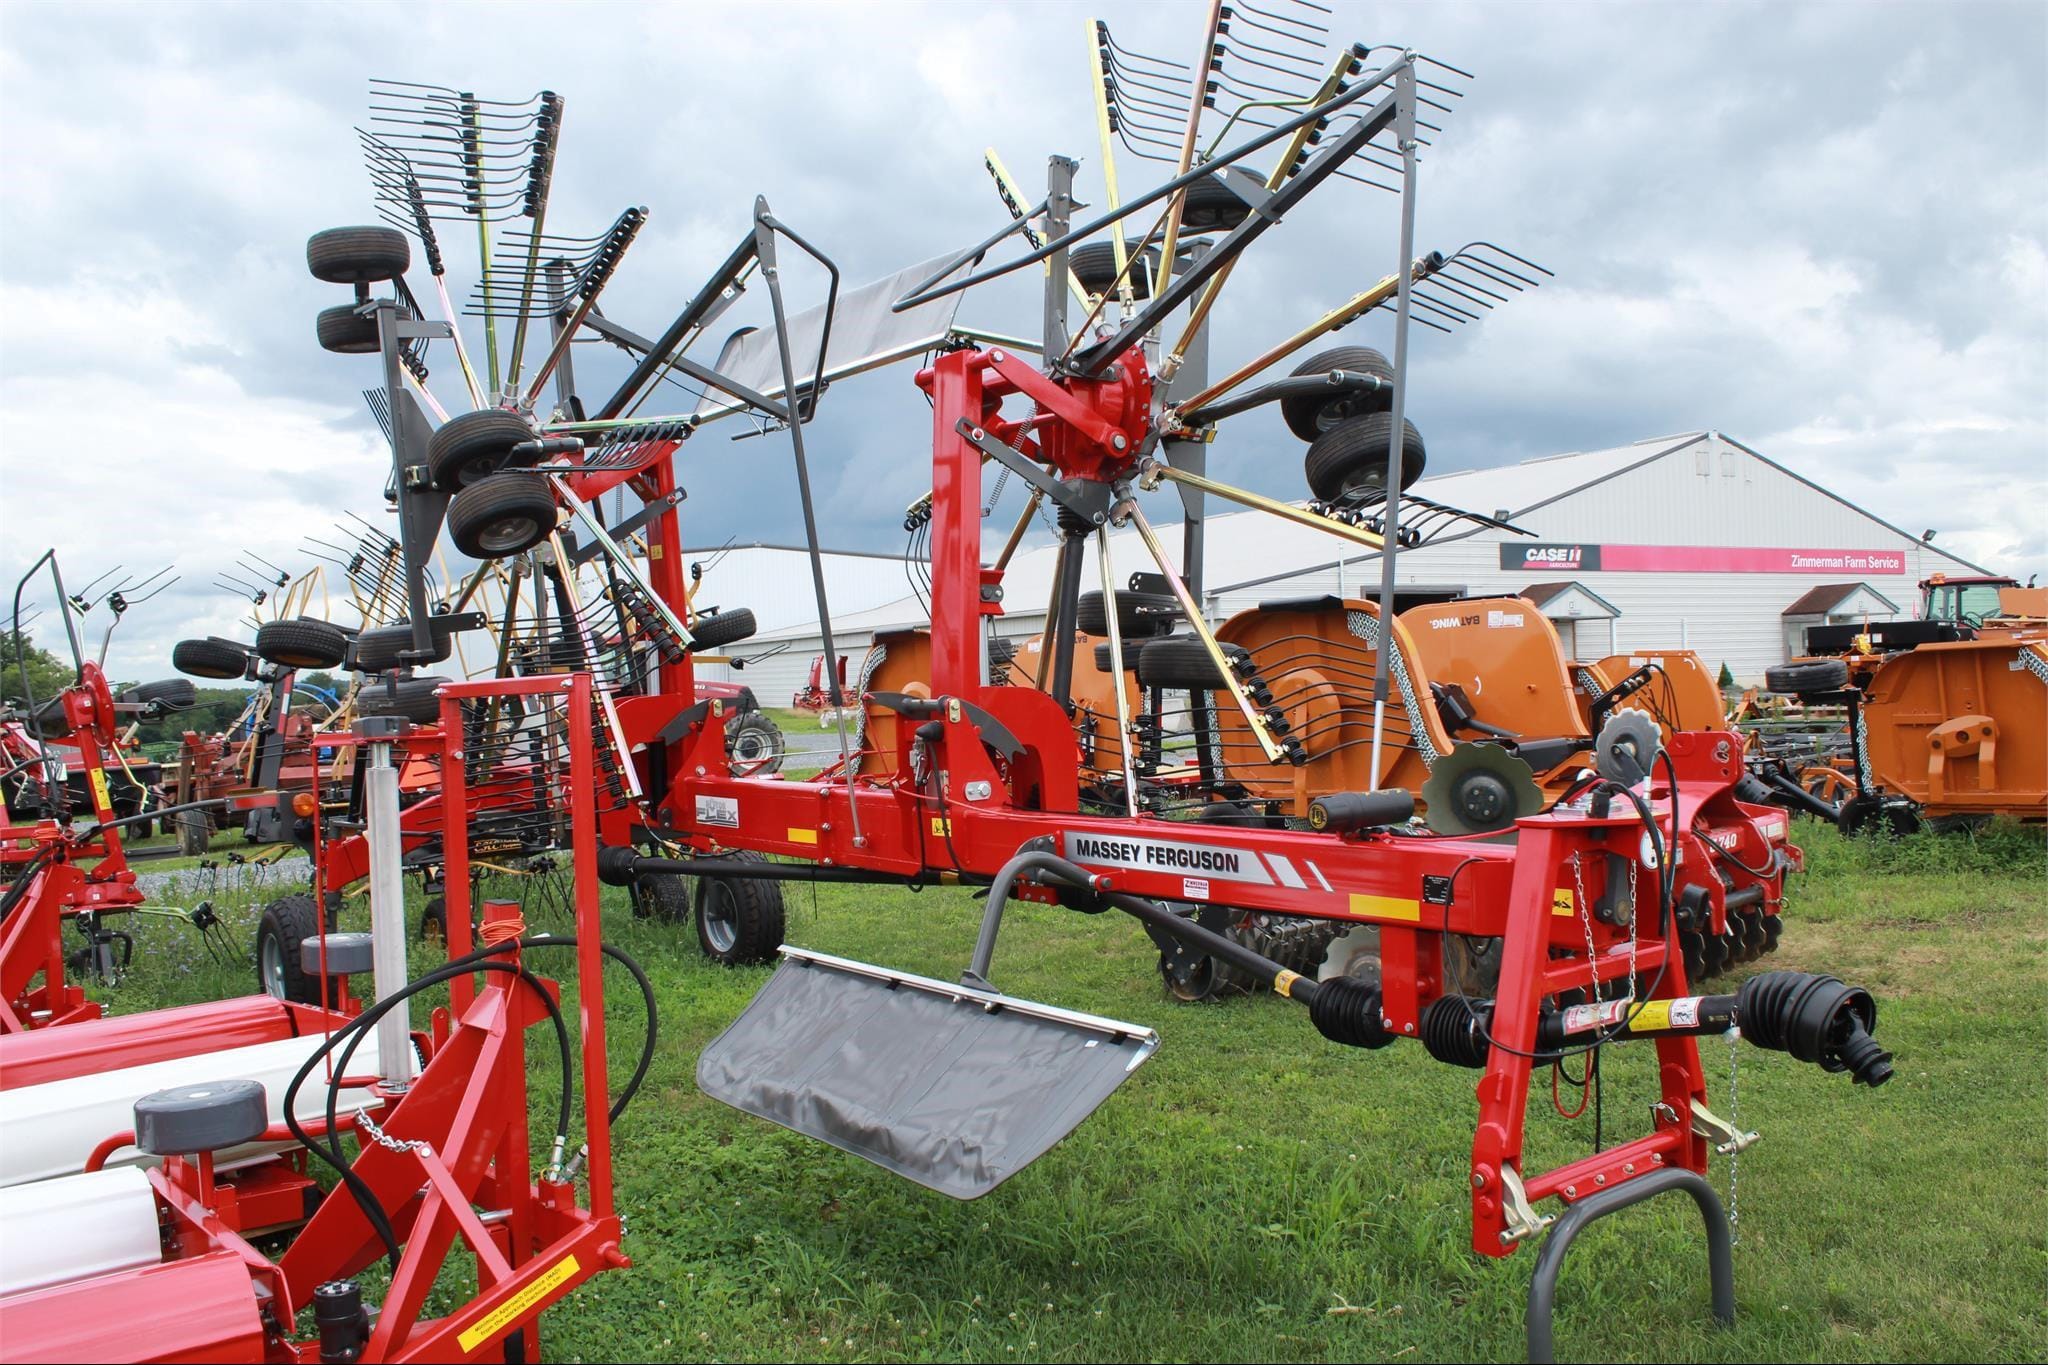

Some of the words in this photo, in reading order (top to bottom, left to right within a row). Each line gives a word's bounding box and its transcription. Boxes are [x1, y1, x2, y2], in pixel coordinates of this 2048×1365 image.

[1525, 548, 1568, 561] CASE
[1791, 555, 1843, 568] Zimmerman
[1845, 556, 1867, 568] Farm
[1868, 556, 1899, 569] Service
[696, 807, 737, 820] FLEX
[1076, 839, 1141, 863] MASSEY
[1146, 845, 1239, 873] FERGUSON
[523, 1279, 545, 1297] Distance
[525, 1286, 547, 1303] machine
